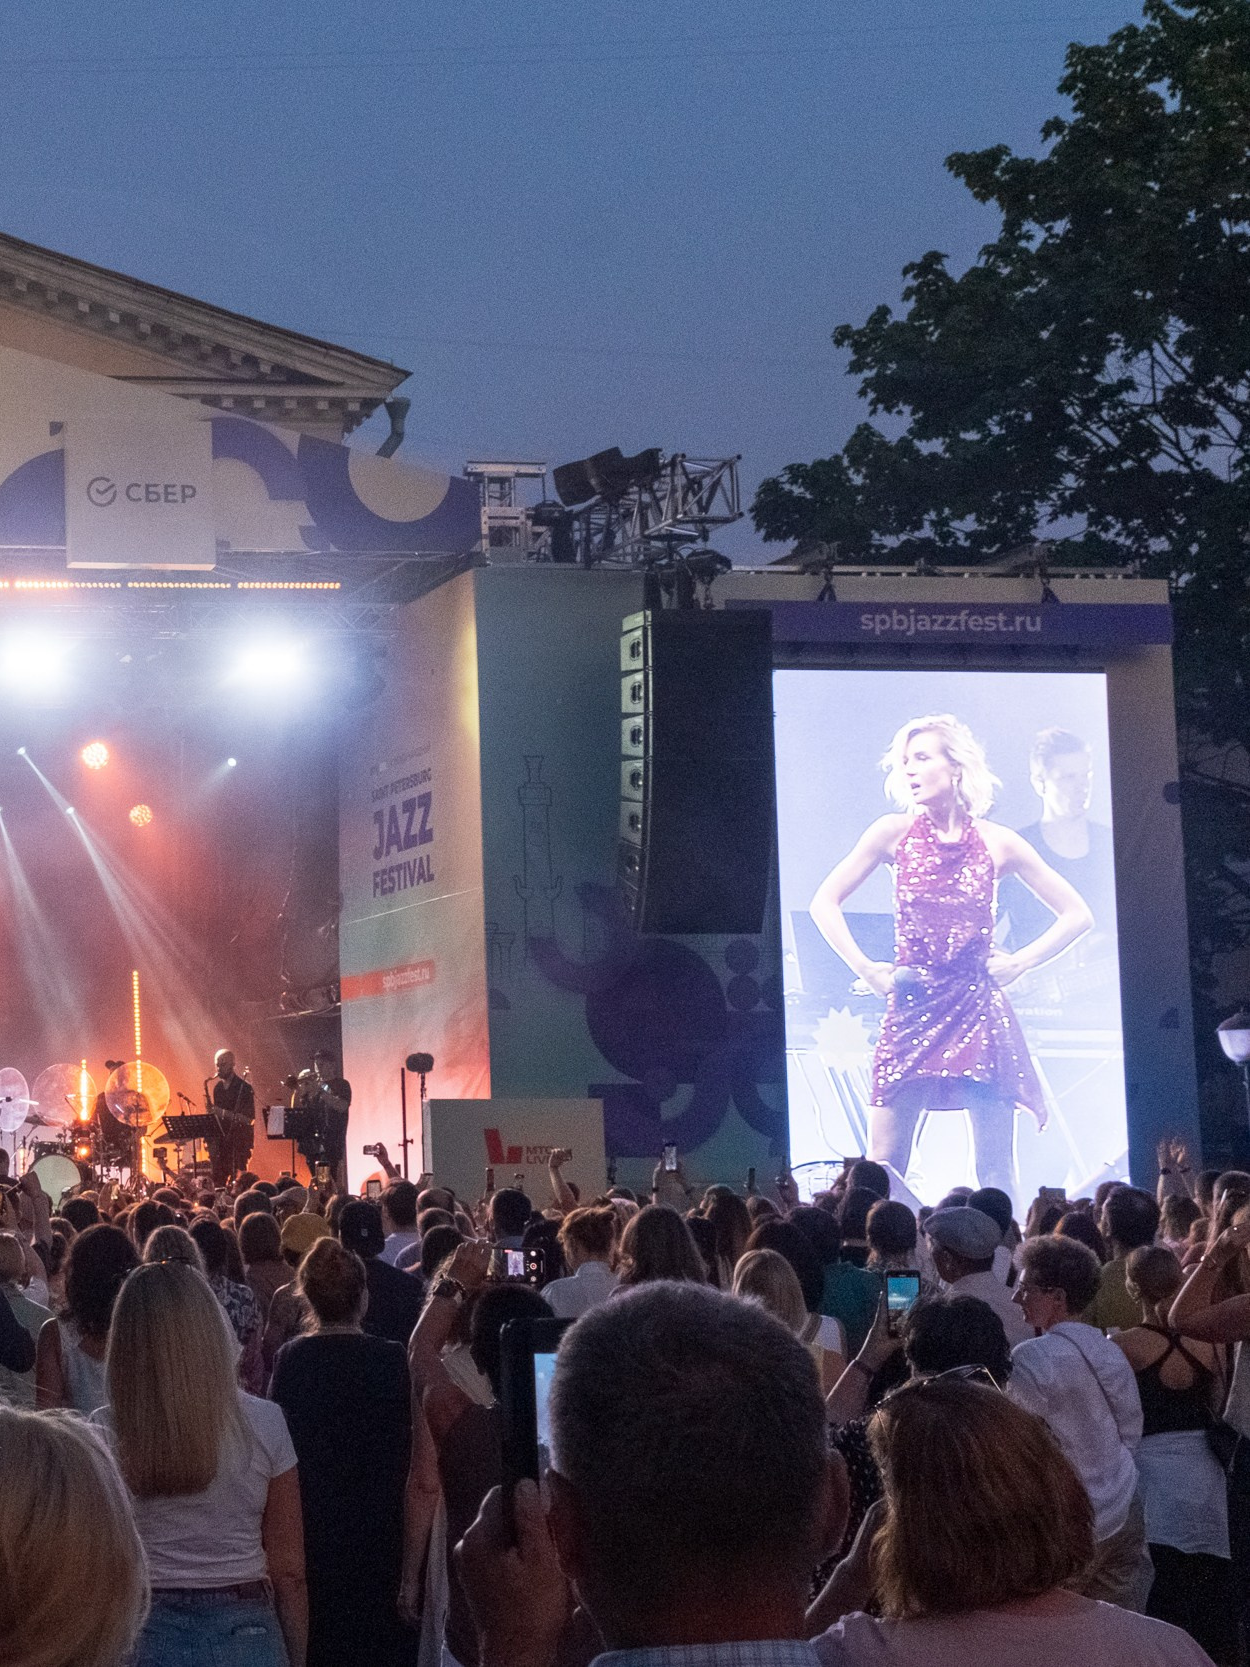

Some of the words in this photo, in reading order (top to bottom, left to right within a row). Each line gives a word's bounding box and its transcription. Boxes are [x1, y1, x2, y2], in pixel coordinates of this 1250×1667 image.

[125, 482, 197, 503] СБЕР
[860, 608, 1042, 636] spbjazzfest.ru
[373, 790, 434, 862] JAZZ
[372, 853, 435, 899] FESTIVAL
